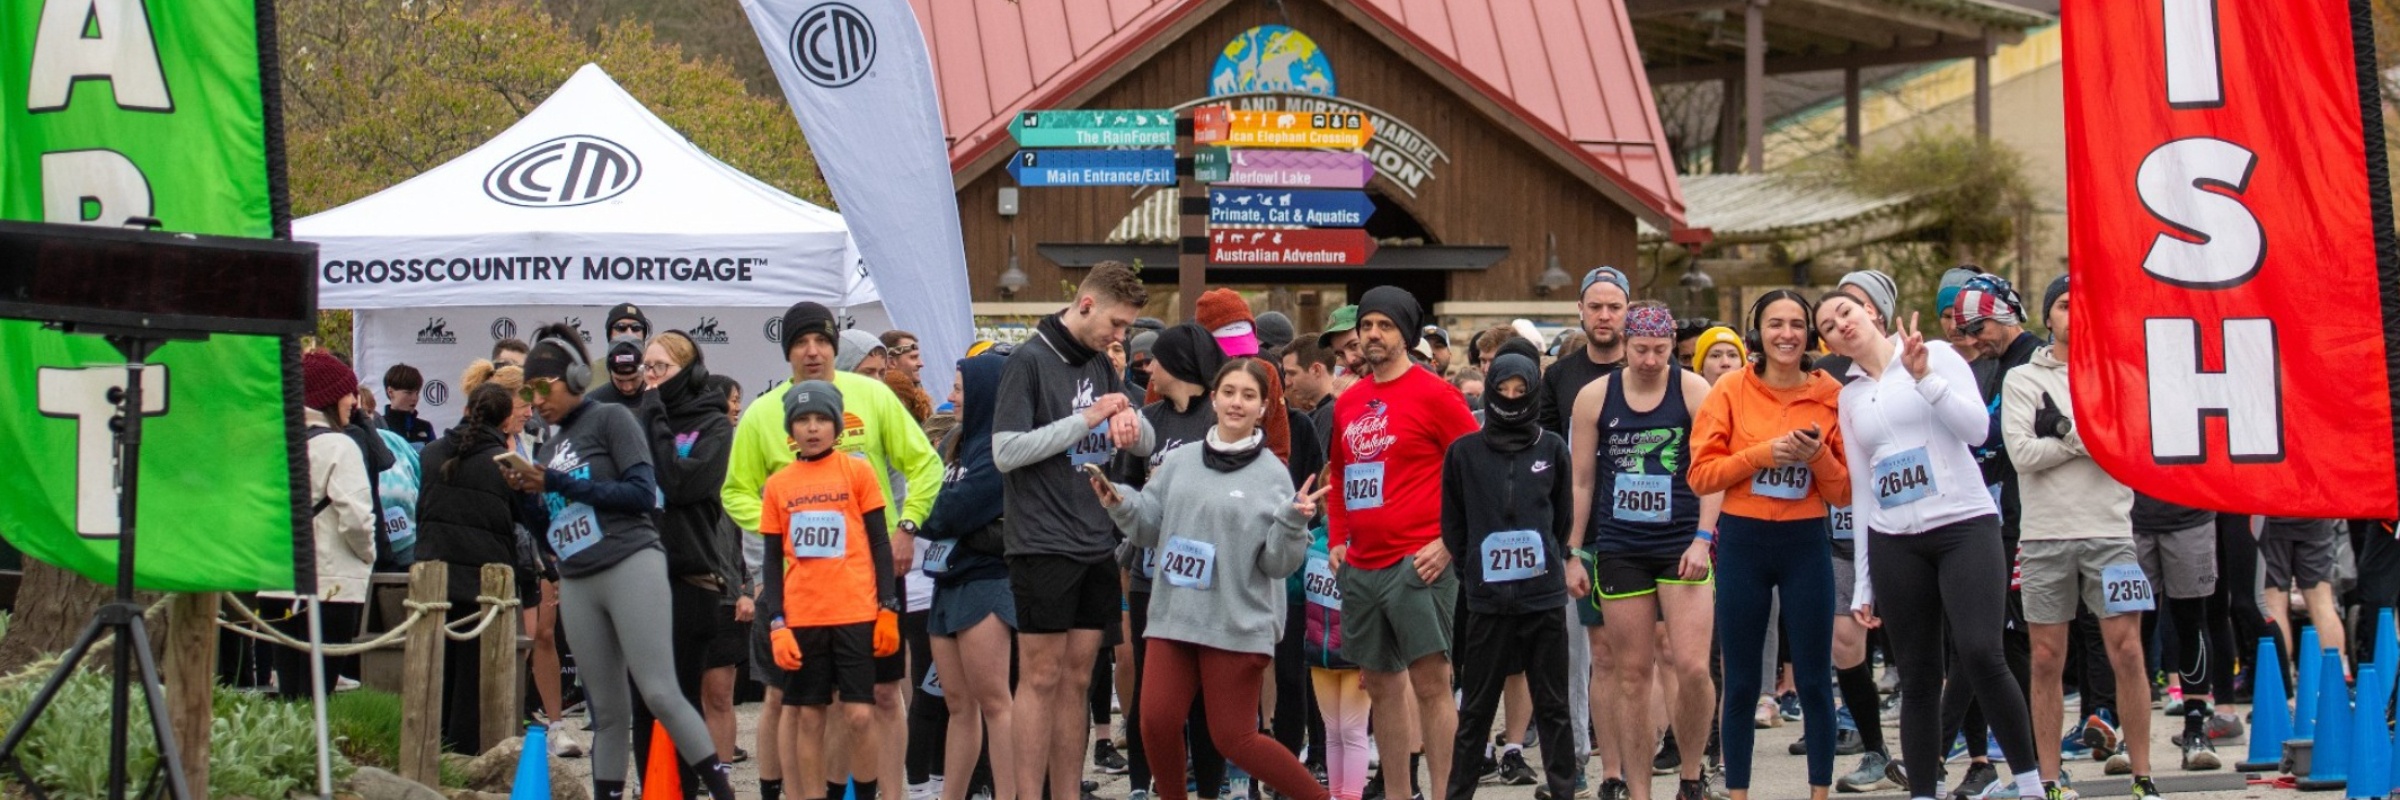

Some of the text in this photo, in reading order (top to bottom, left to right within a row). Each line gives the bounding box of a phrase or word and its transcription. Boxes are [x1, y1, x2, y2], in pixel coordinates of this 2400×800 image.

[797, 9, 869, 81] CCM
[1076, 130, 1170, 144] The RainForest
[1230, 130, 1254, 142] ican
[1258, 131, 1307, 144] Elephant
[1309, 131, 1359, 145] Crossing
[1240, 96, 1277, 111] AND
[1285, 97, 1361, 113] MORT
[1371, 115, 1438, 168] MANDEL
[497, 141, 629, 202] CCM
[1047, 169, 1170, 184] Main Entrance/Exit
[1229, 170, 1278, 183] aterfowl
[1282, 171, 1311, 185] Lake
[1211, 207, 1360, 225] Primate, Cat & Aquatics
[2136, 0, 2285, 464] ISH
[1215, 248, 1345, 263] Australian Adventure
[323, 256, 573, 284] CROSSCOUNTRY
[1075, 432, 1107, 454] 2424
[1609, 432, 1630, 444] Red
[1346, 477, 1379, 500] 2426
[1756, 466, 1808, 489] 2643
[1878, 464, 1929, 498] 2644
[787, 493, 850, 508] ARMOUR
[1617, 489, 1666, 512] 2605
[553, 515, 592, 549] 2415
[1834, 512, 1852, 530] 25
[794, 526, 840, 548] 2607
[1163, 551, 1206, 580] 2427
[1489, 546, 1536, 571] 2715
[2108, 580, 2151, 603] 2350
